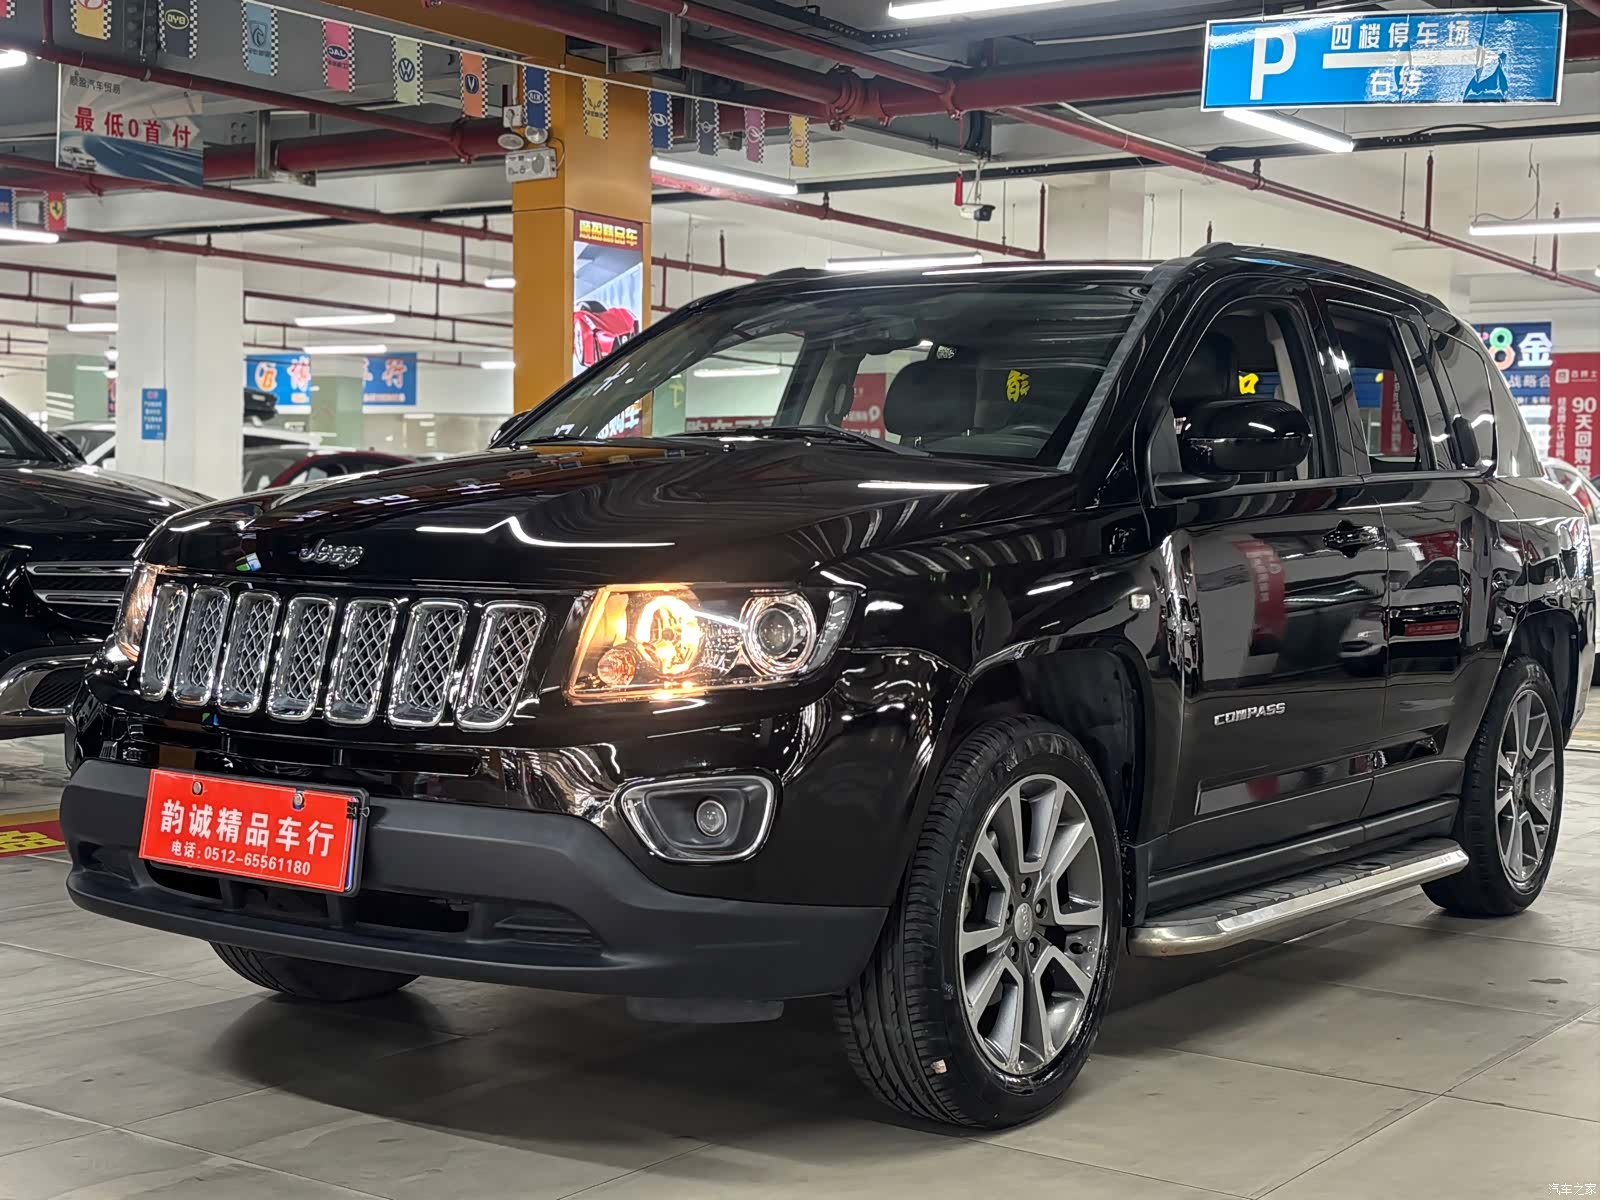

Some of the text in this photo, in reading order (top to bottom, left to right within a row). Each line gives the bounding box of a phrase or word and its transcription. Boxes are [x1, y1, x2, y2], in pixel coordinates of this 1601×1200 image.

[1331, 20, 1470, 50] 四楼停车场
[1249, 27, 1297, 100] P
[74, 106, 192, 149] 最低0首付
[298, 538, 364, 570] Jeep
[1214, 702, 1286, 726] COMPASS
[160, 798, 335, 857] 韵诚精品车行
